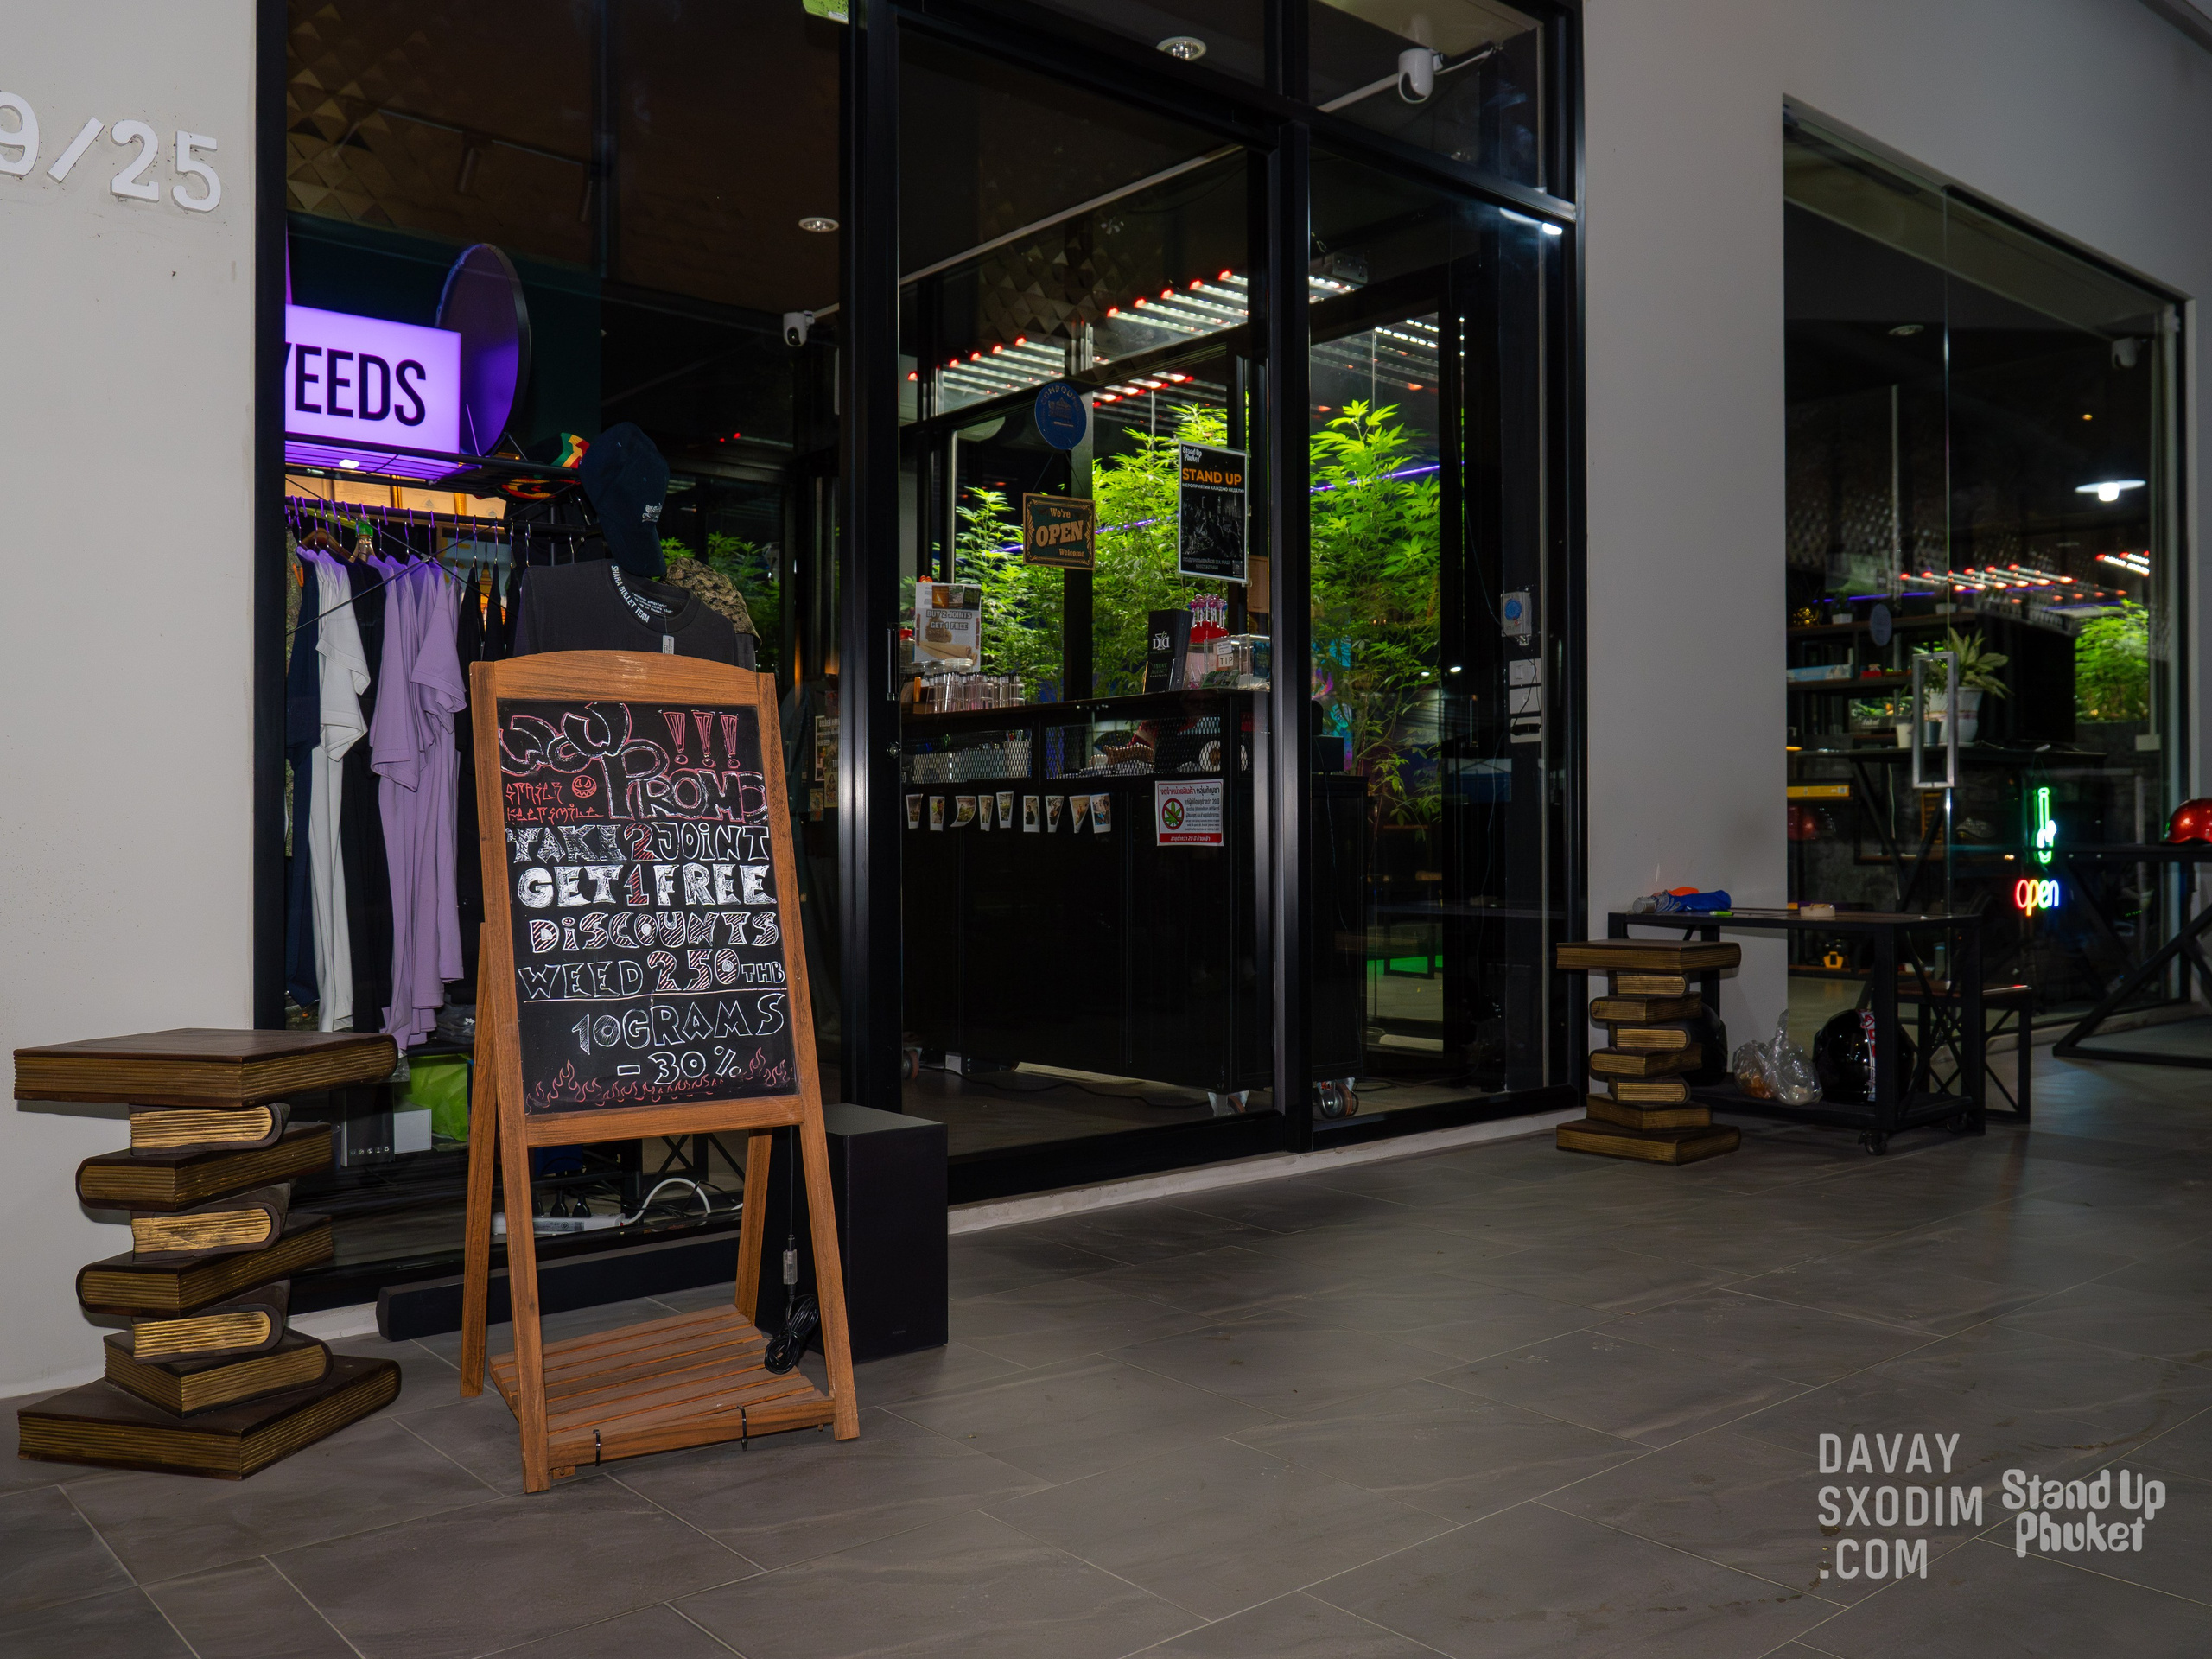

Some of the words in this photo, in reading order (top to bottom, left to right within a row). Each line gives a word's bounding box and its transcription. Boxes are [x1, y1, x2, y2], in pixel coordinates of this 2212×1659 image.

[285, 342, 427, 428] EEDS
[1182, 467, 1223, 484] STAND
[1225, 472, 1243, 486] UP
[1050, 507, 1071, 518] We're
[1036, 520, 1084, 548] OPEN
[1058, 548, 1085, 557] Welcome
[619, 586, 637, 608] BULLET
[634, 607, 650, 623] TEAM
[926, 609, 942, 618] BUY
[948, 611, 972, 620] JOINTS
[1219, 656, 1233, 665] TIP
[505, 823, 627, 863] TAKE
[624, 823, 663, 862] 2
[518, 864, 624, 908] GET
[623, 863, 650, 906] 1
[653, 863, 778, 906] FREE
[2014, 878, 2059, 916] open
[518, 960, 643, 999] WEED
